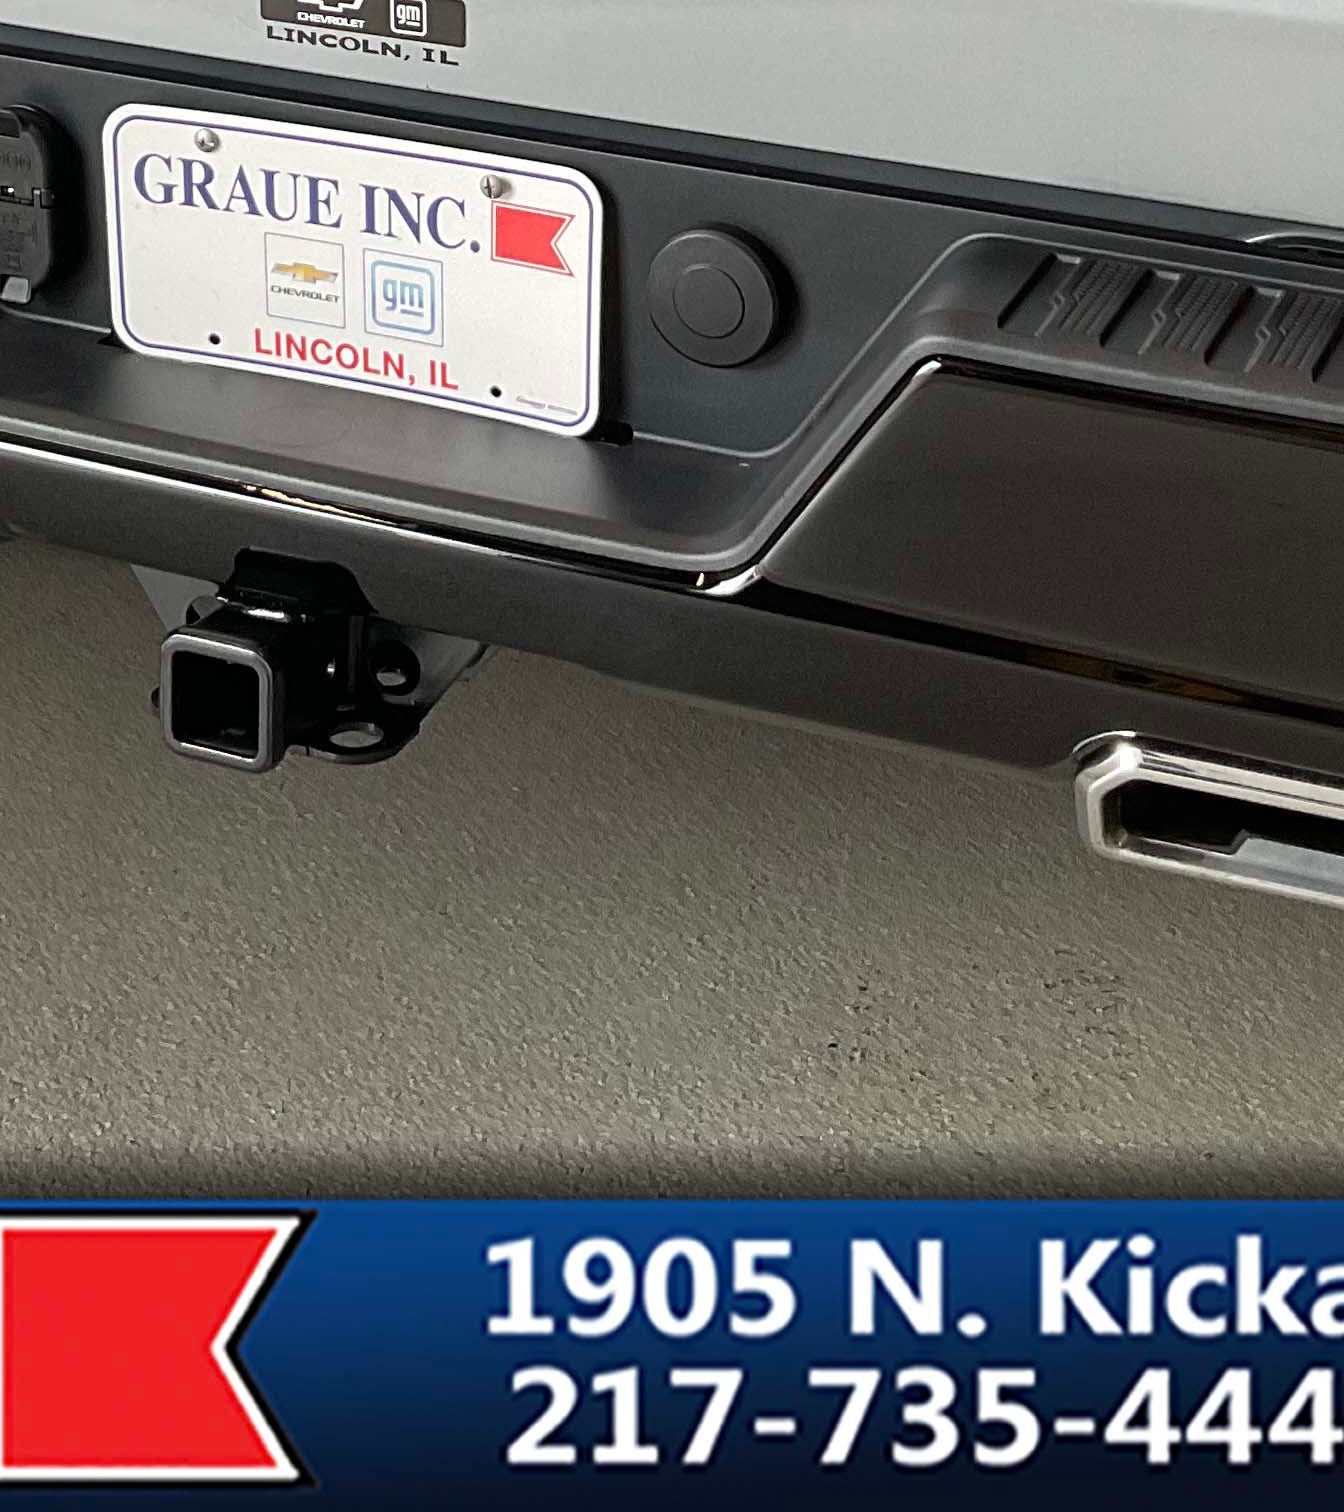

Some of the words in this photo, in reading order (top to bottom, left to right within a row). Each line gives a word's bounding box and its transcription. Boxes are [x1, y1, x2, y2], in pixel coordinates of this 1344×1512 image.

[296, 11, 366, 29] CHEVROLET
[396, 3, 422, 27] gm
[266, 25, 411, 61] LINCOLN,
[422, 47, 460, 66] IL
[133, 153, 343, 230] GRAUE
[359, 183, 482, 254] INC.
[270, 284, 341, 304] CHEVROLET
[382, 278, 425, 318] gm
[254, 327, 416, 387] LINCOLN,
[429, 359, 460, 390] IL
